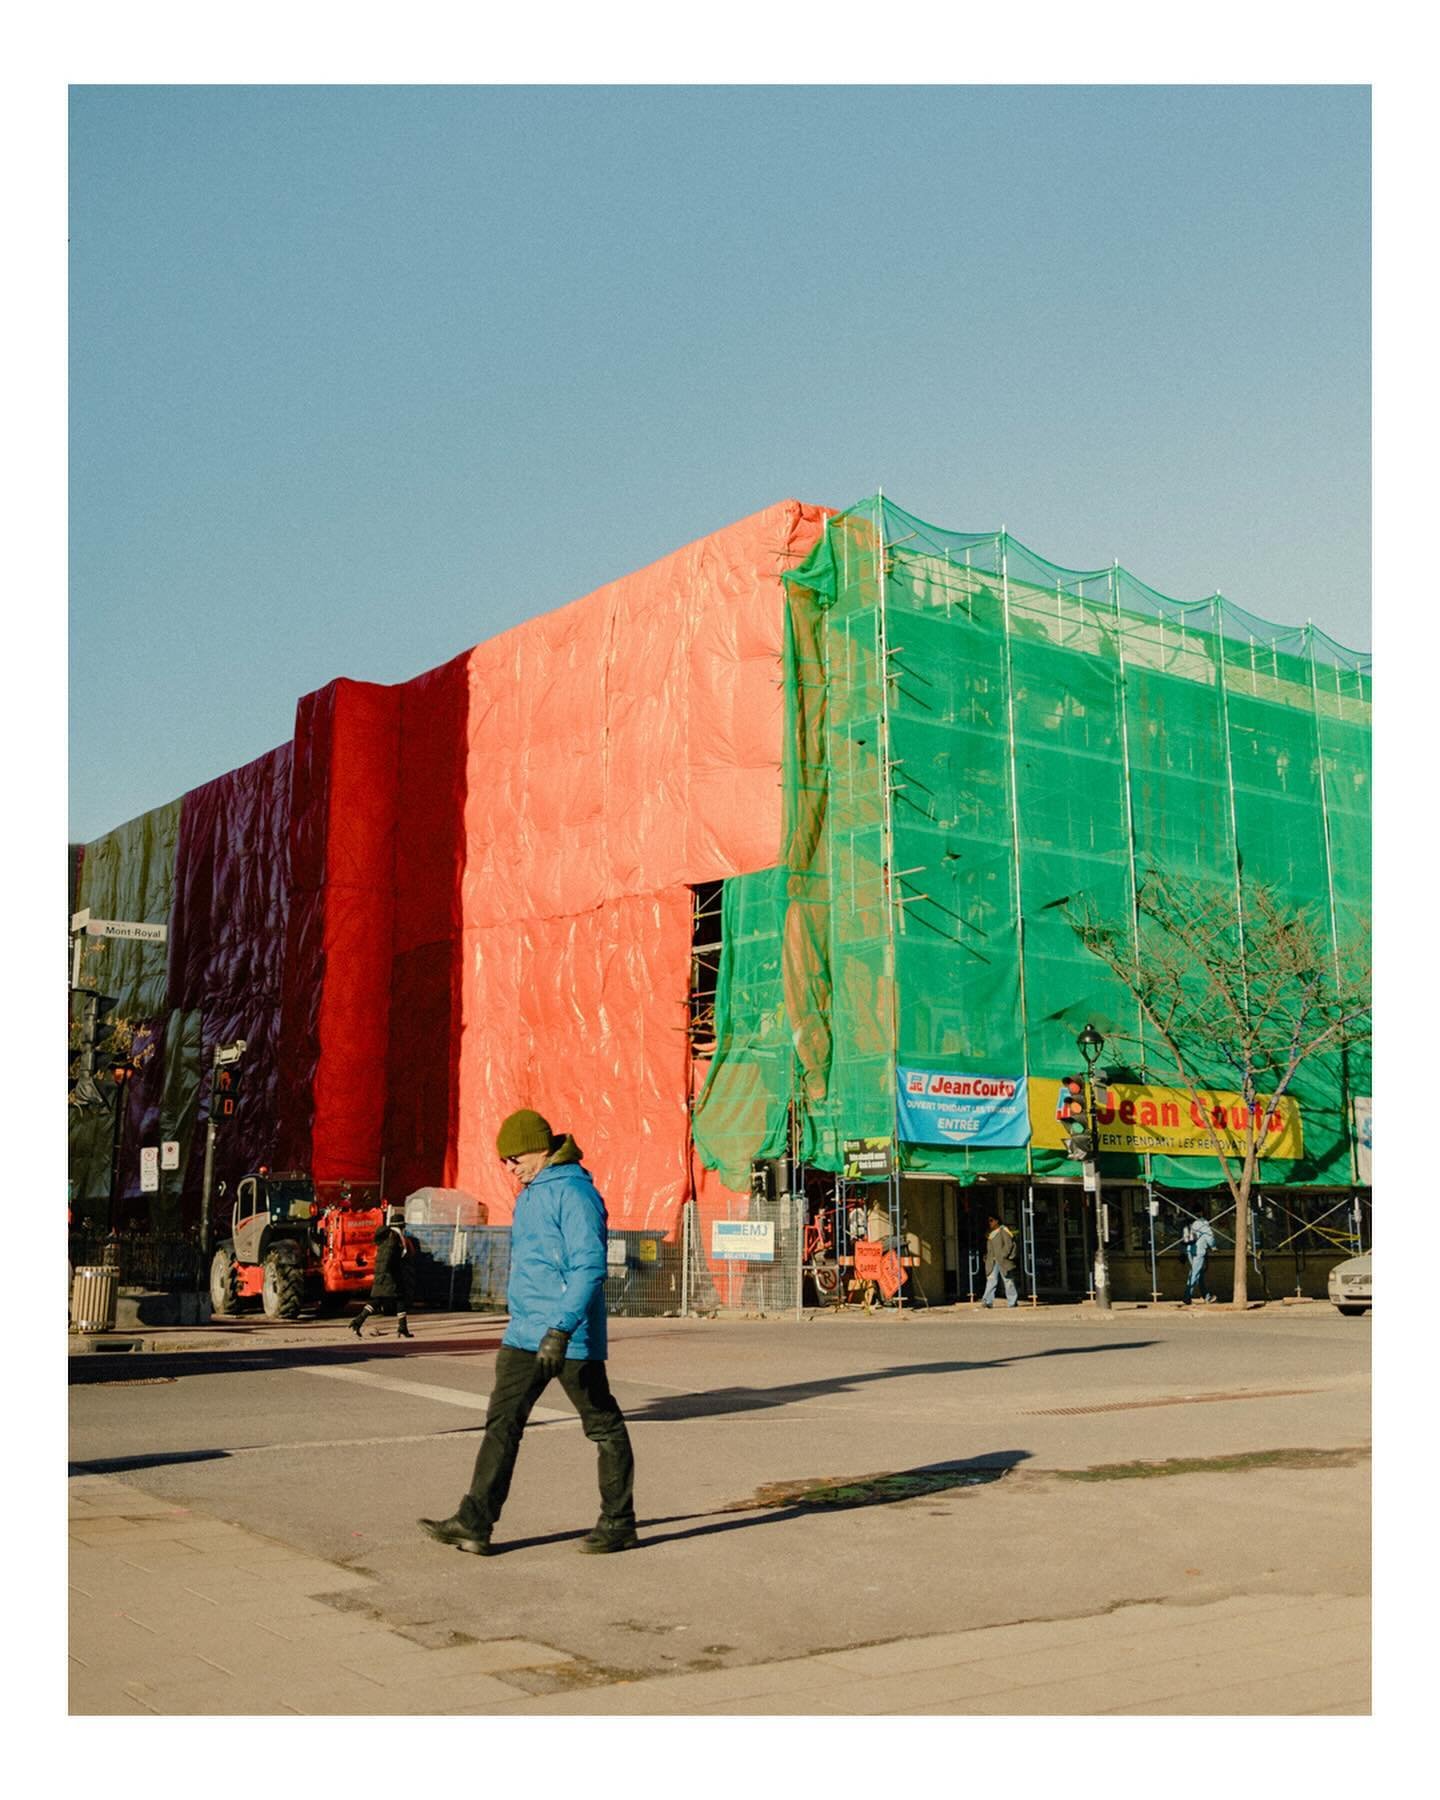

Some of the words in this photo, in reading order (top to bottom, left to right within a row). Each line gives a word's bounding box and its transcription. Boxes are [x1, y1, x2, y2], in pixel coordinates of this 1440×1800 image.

[105, 926, 161, 938] Mont-Royal
[931, 1077, 971, 1095] Jean
[1097, 1091, 1179, 1127] Jean
[938, 1117, 980, 1131] ENTRÉE
[1097, 1133, 1122, 1145] ERT
[1126, 1136, 1174, 1147] PENDANT
[1178, 1138, 1194, 1148] LES
[743, 1224, 767, 1236] EMJ
